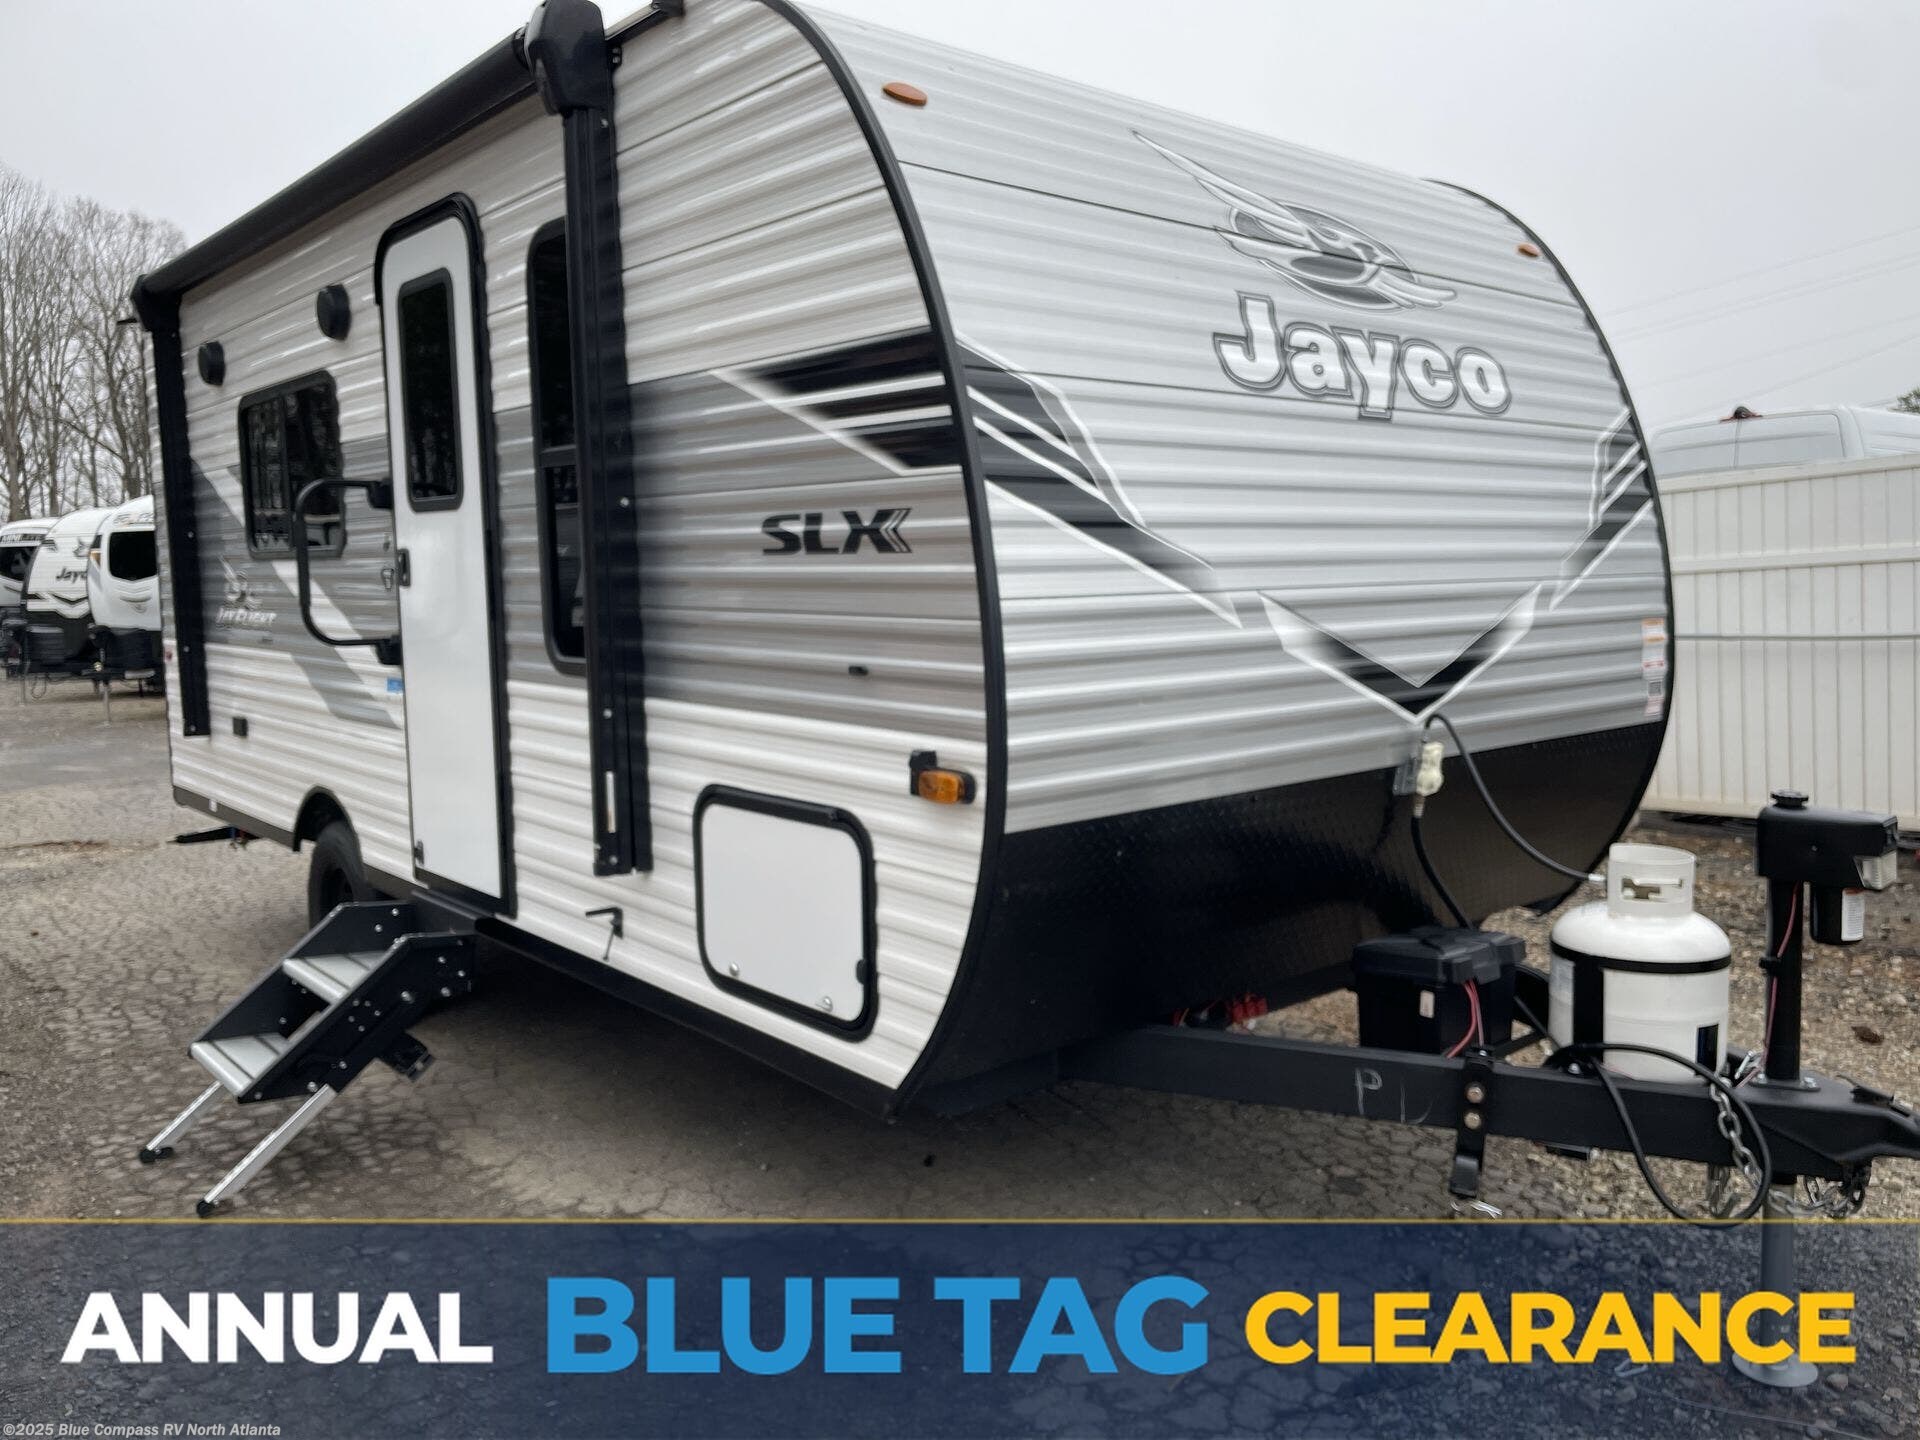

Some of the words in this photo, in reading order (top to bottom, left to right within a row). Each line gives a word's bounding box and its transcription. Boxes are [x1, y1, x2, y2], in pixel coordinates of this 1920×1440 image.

[1213, 291, 1512, 421] Jayco
[762, 508, 911, 555] SLX
[56, 568, 88, 583] Jayc
